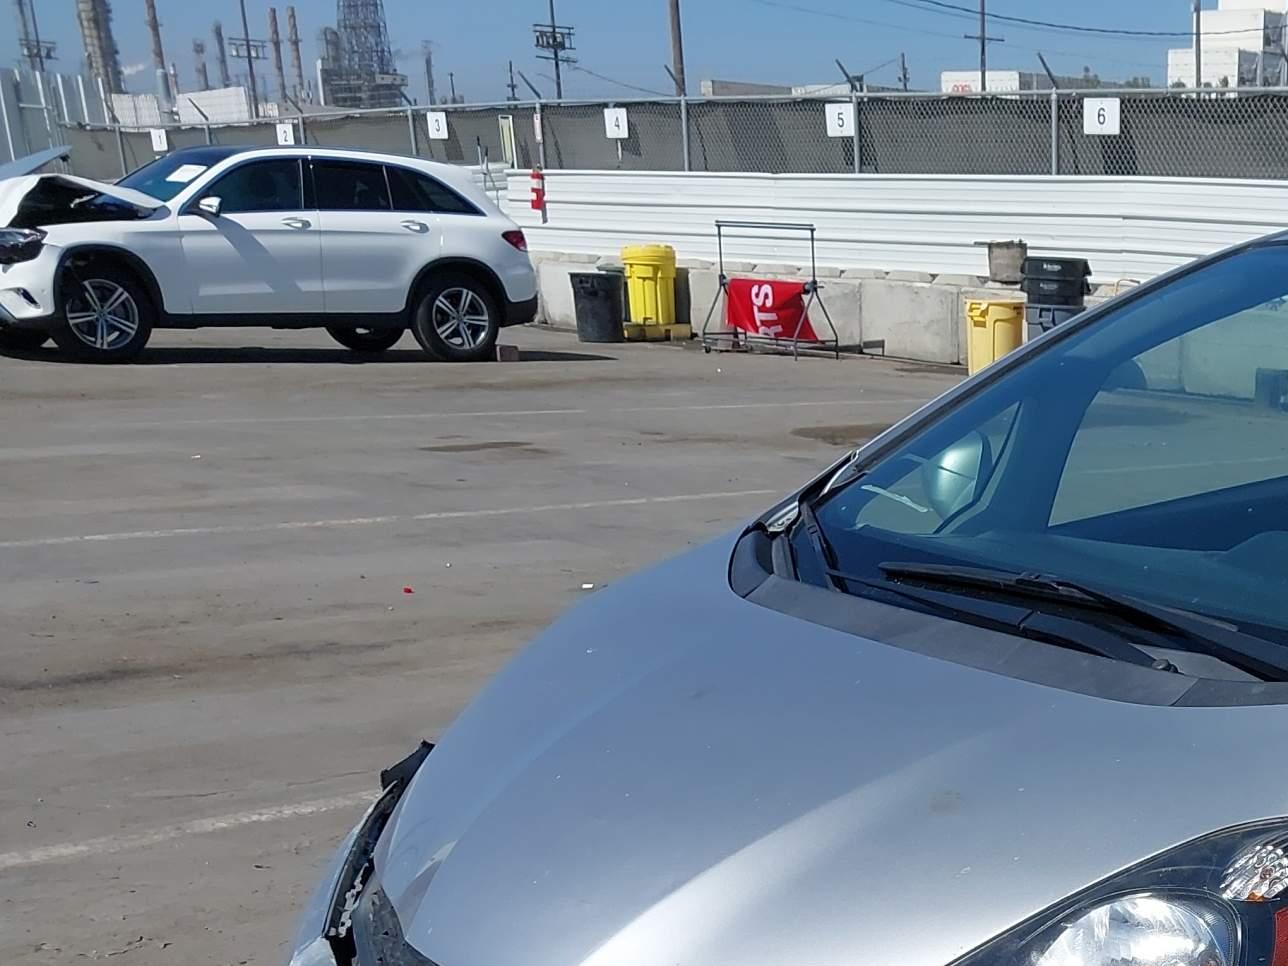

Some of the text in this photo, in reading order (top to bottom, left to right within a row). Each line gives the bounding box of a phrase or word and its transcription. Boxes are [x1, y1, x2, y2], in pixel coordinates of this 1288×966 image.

[613, 115, 621, 131] 4
[837, 111, 845, 128] 5
[1097, 107, 1106, 126] 6
[434, 118, 441, 133] 3
[282, 129, 290, 143] 2
